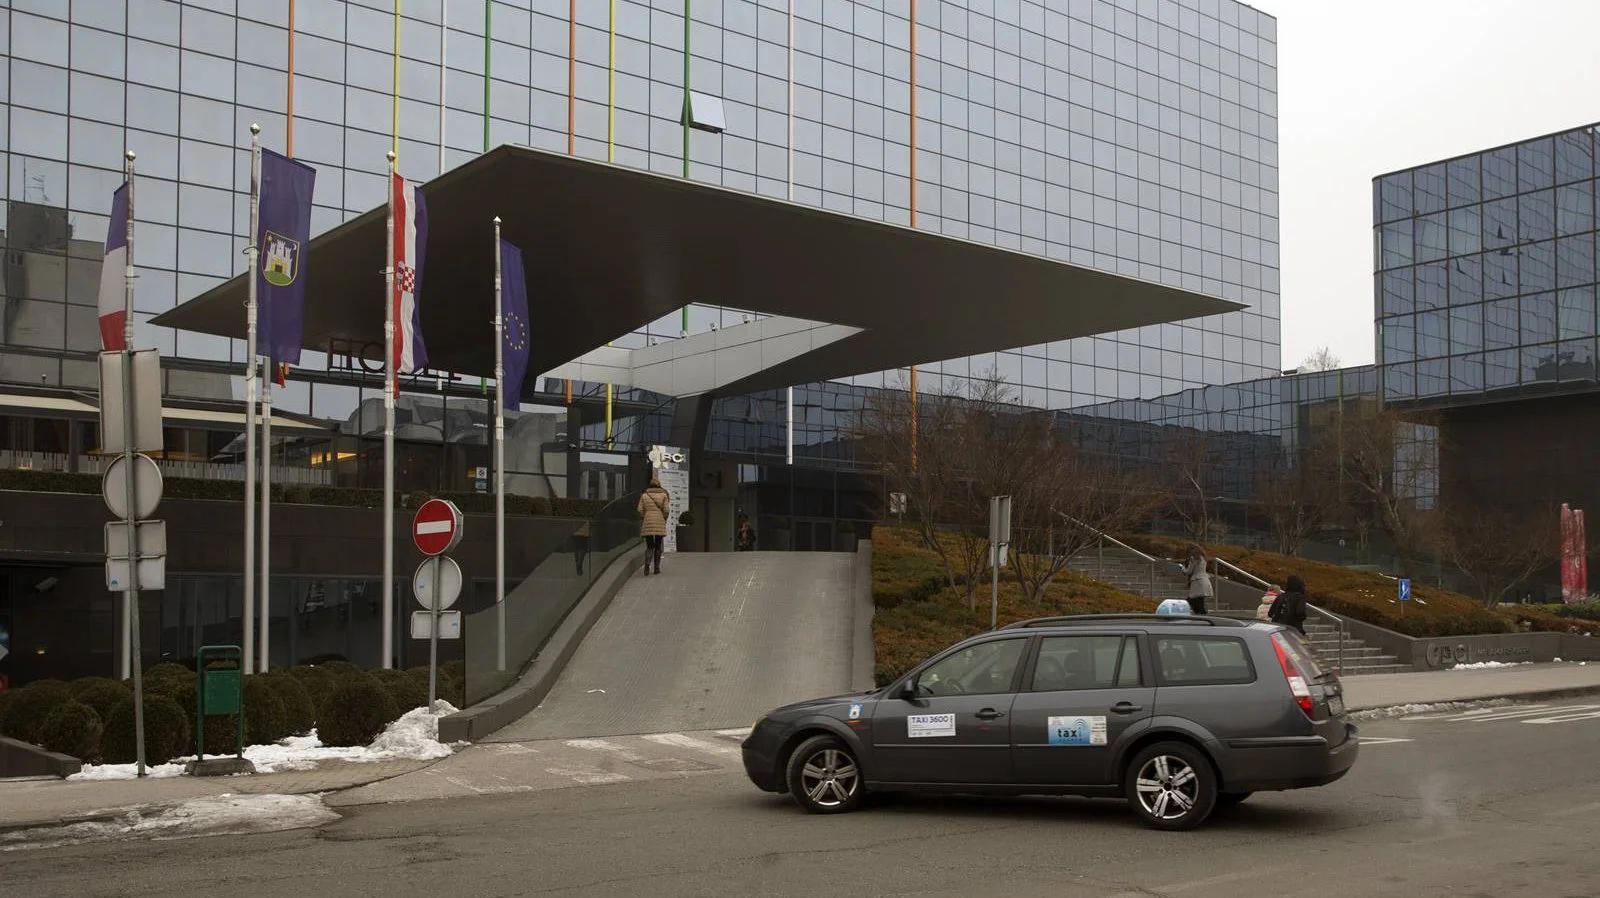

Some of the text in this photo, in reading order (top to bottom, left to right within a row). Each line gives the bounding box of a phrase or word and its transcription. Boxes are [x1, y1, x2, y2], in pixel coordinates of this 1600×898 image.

[911, 716, 928, 724] TAXI
[929, 715, 949, 723] 3600
[1057, 726, 1082, 738] taxi
